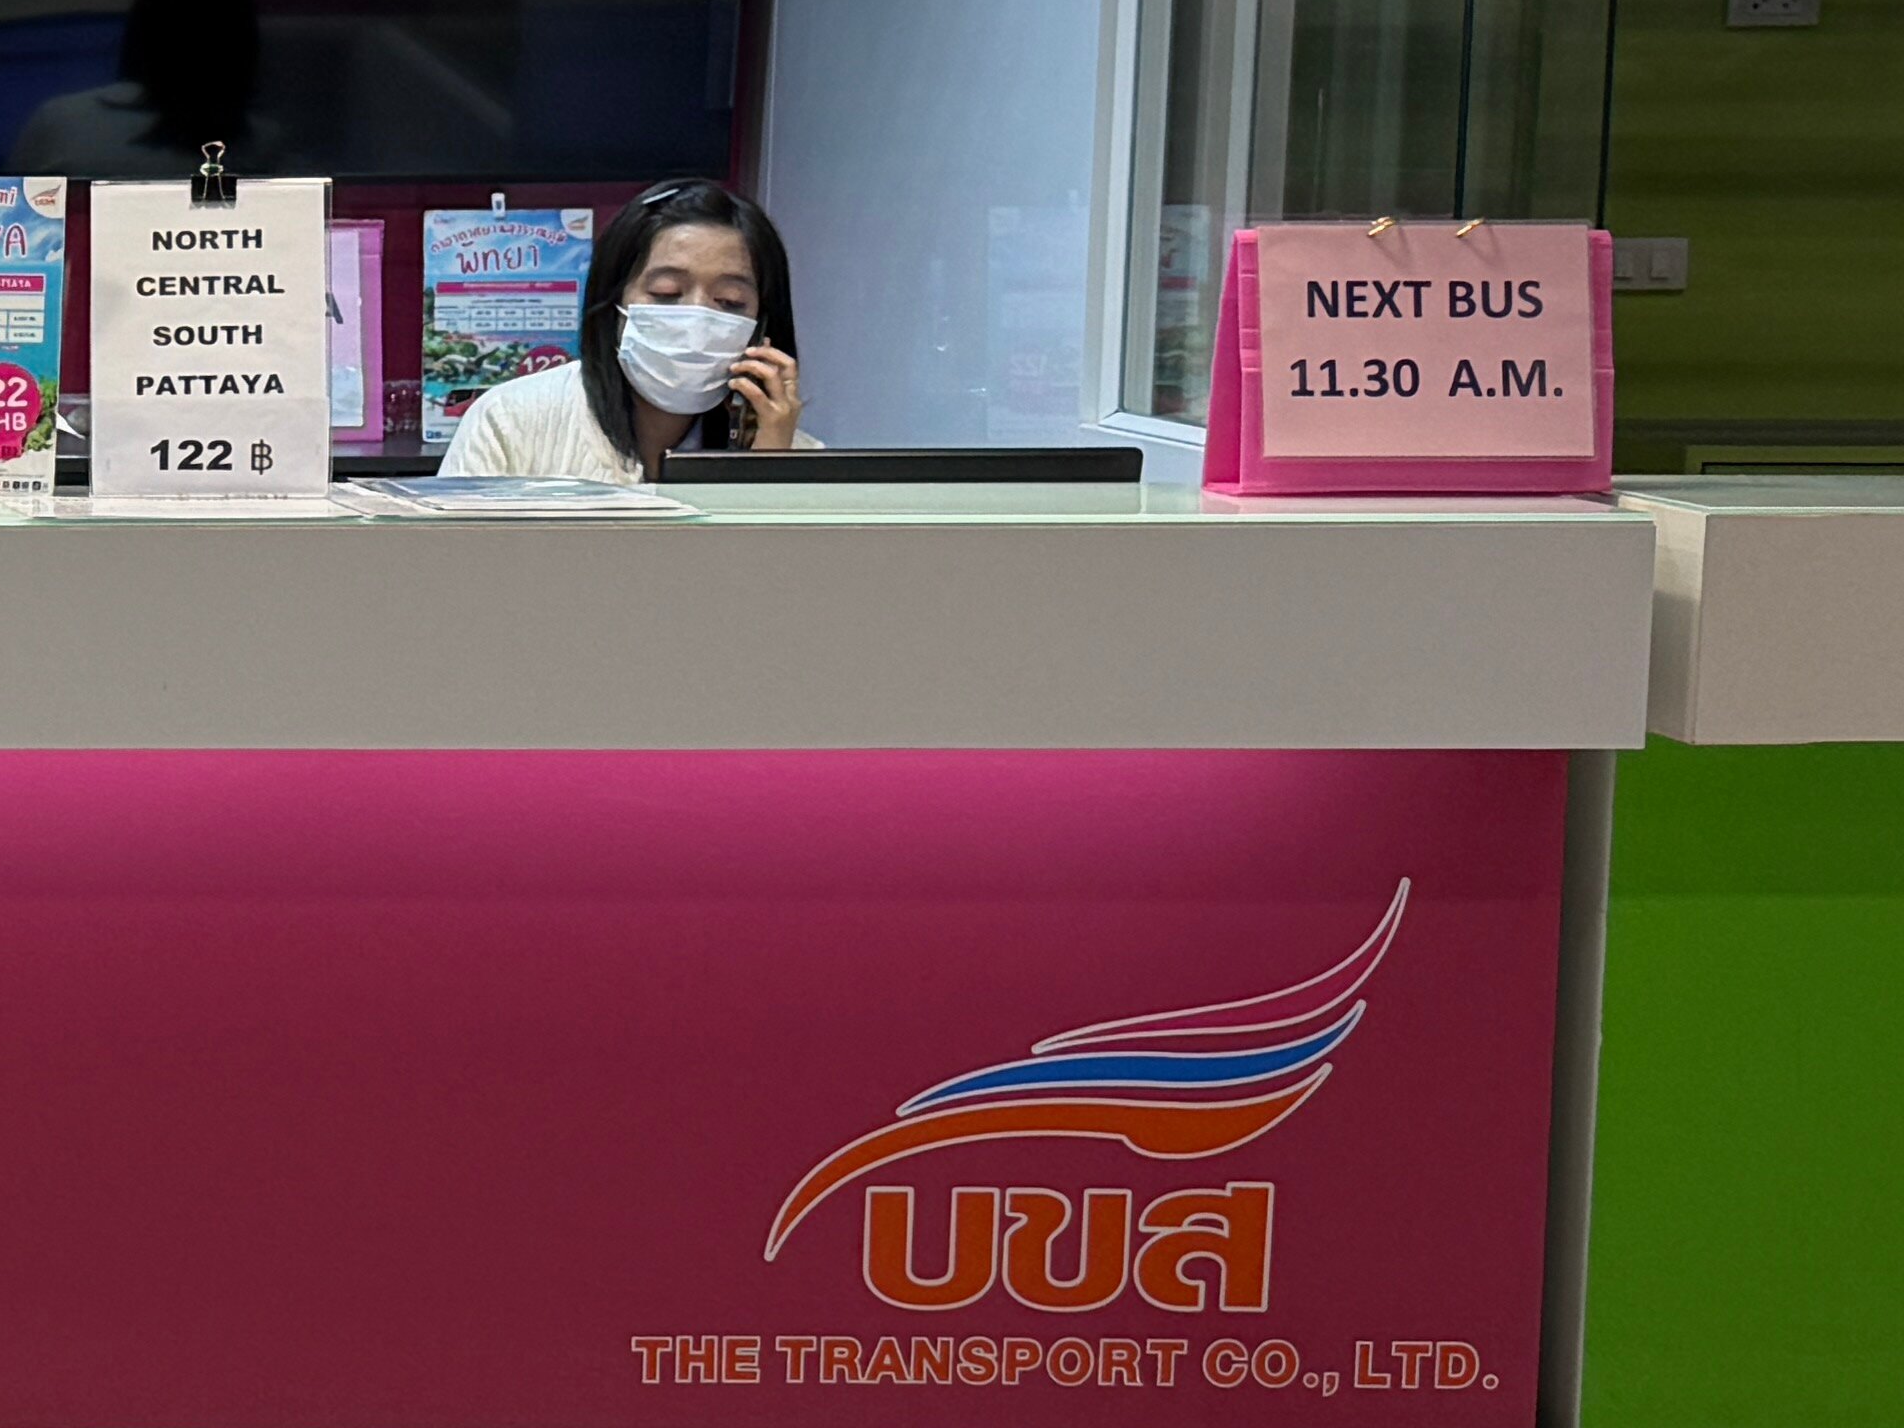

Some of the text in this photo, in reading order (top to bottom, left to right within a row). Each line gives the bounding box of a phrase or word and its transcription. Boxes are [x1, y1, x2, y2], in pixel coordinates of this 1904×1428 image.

[152, 229, 263, 251] NORTH
[456, 241, 539, 274] พัทยา
[136, 274, 285, 296] CENTRAL
[1306, 280, 1543, 318] NEXT BUS
[152, 324, 263, 346] SOUTH
[136, 373, 285, 396] PATTAYA
[1290, 358, 1563, 397] 11.30 A.M.
[150, 439, 233, 471] 122
[863, 1179, 1276, 1313] บขส
[630, 1336, 761, 1385] THE
[775, 1336, 1188, 1390] TRANSPORT
[1353, 1340, 1501, 1392] LTD.
